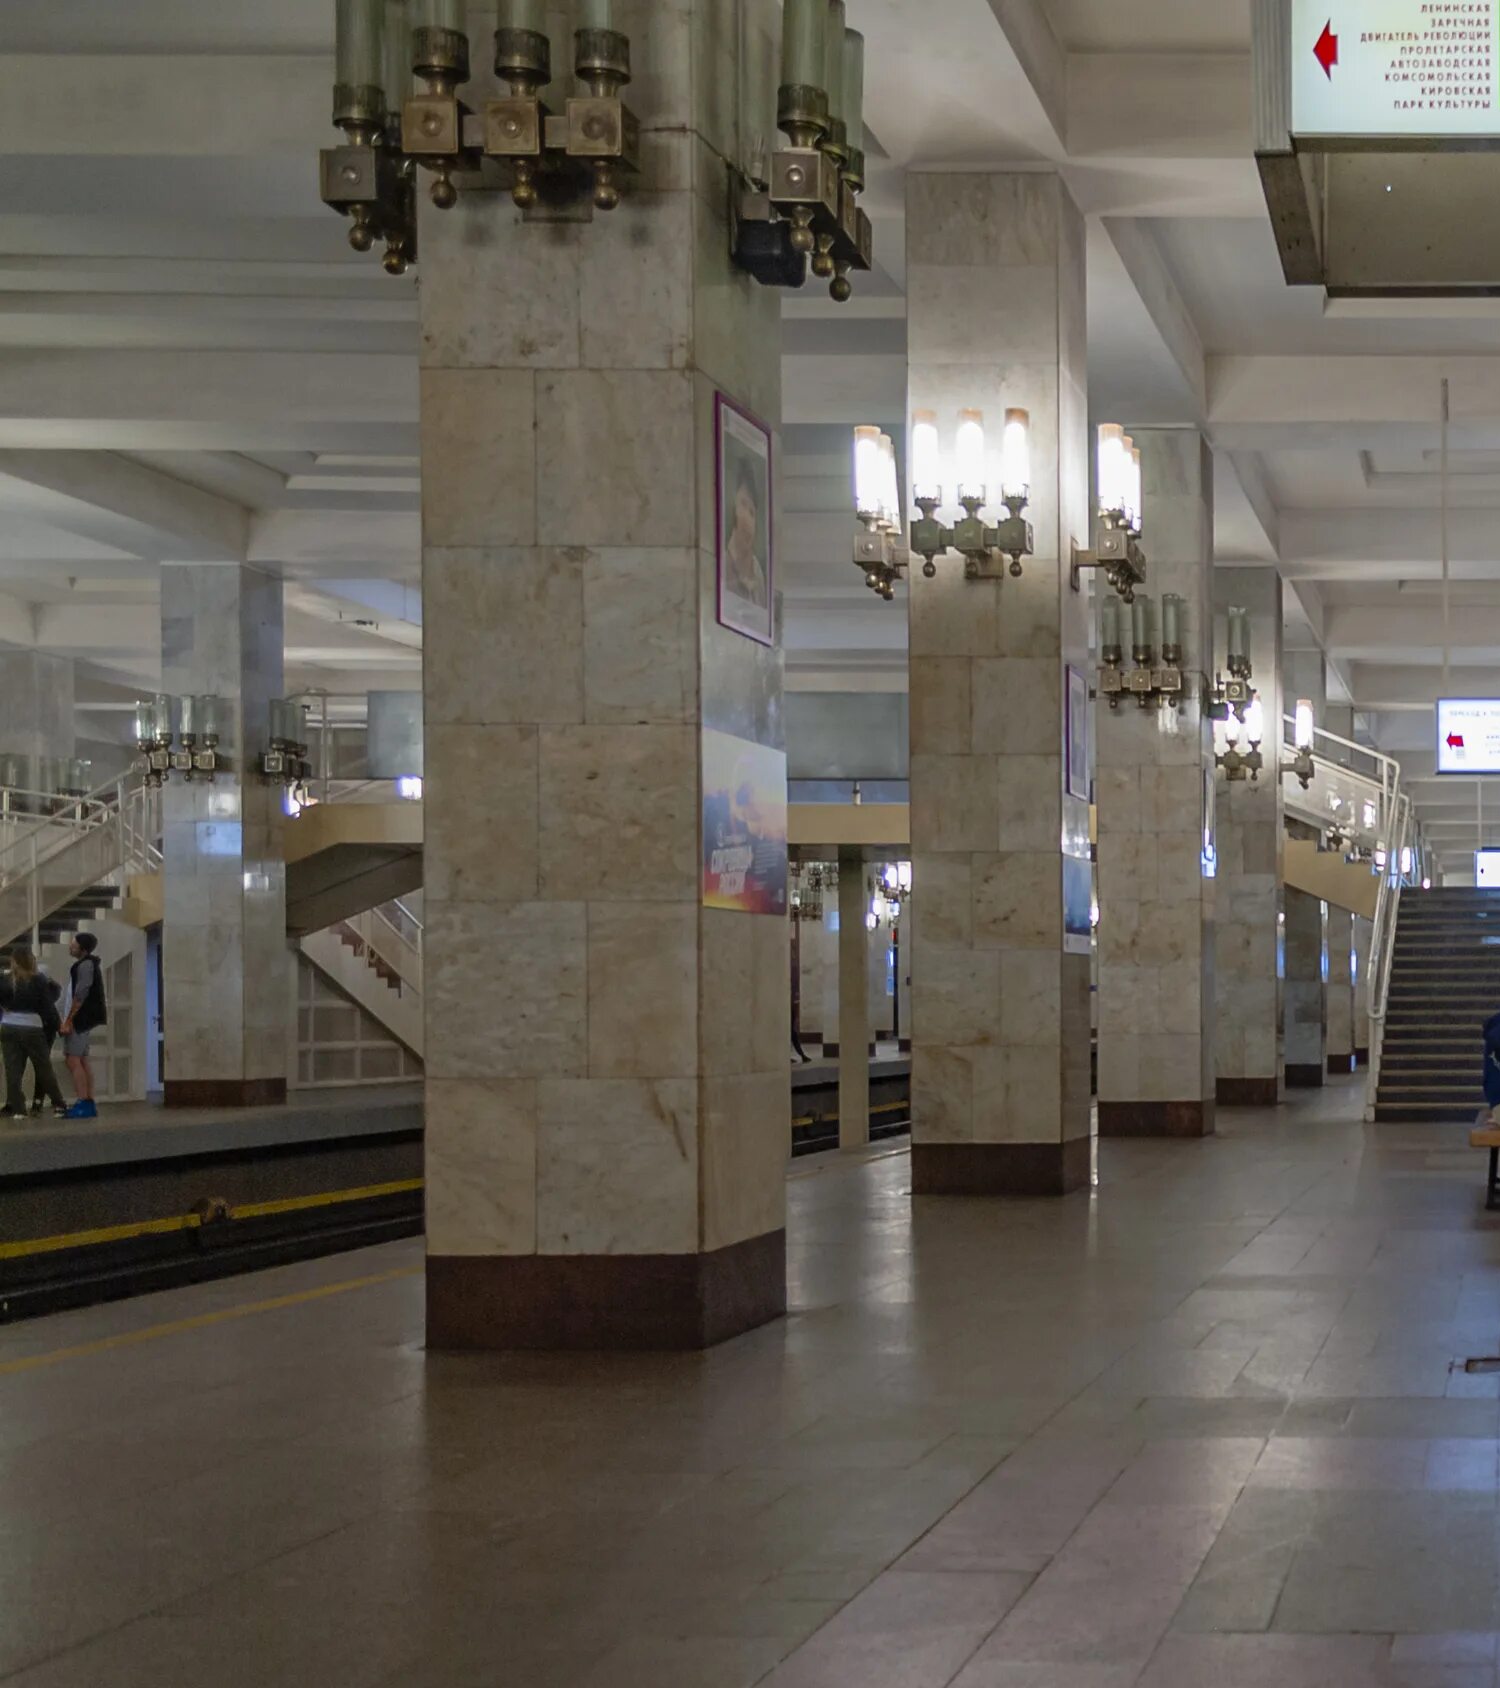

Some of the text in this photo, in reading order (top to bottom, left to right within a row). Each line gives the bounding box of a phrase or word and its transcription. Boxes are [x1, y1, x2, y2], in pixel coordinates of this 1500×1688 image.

[1421, 3, 1491, 13] ЛЕНИНСКАЯ
[1431, 18, 1491, 27] ЗАРЕЧНАЯ
[1360, 31, 1491, 42] ДВИГАТЕЛЬ РЕВОЛЮЦИИ
[1400, 45, 1491, 55] ПРОЛЕТАРСКАЯ
[1390, 58, 1491, 68] АВТОЗАВОДСКАЯ
[1384, 72, 1491, 82] КОМСОМОЛЬСКАЯ
[1421, 86, 1491, 96] КИРОВСКАЯ
[1394, 100, 1491, 109] ПАРК КУЛЬТУРЫ
